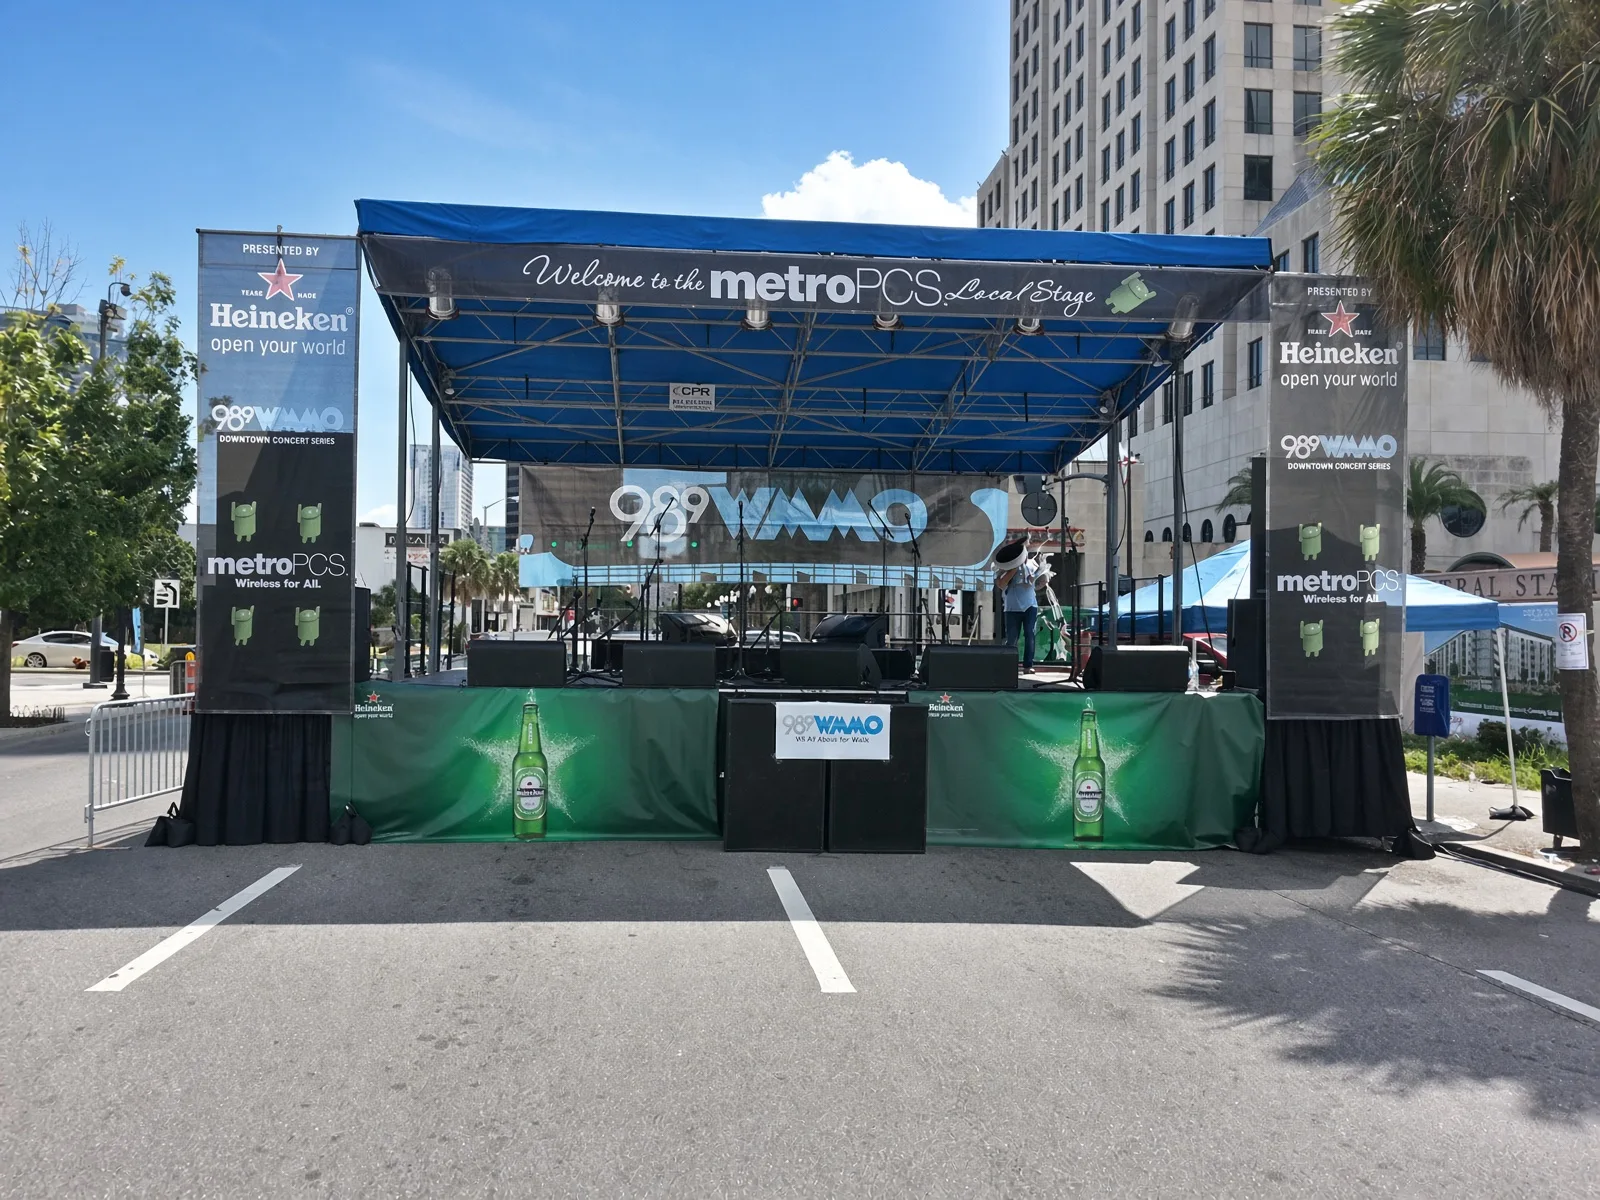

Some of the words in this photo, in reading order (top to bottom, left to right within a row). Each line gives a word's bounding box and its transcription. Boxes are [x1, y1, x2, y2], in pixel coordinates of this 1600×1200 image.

[242, 243, 302, 256] PRESENTED
[305, 246, 319, 257] BY
[522, 254, 645, 288] Welcome
[650, 272, 670, 290] to
[674, 268, 705, 291] the
[944, 277, 1034, 301] Local
[1029, 279, 1096, 317] Stage
[1307, 287, 1358, 297] PRESENTED
[1361, 288, 1373, 297] BY
[211, 337, 254, 355] open
[259, 339, 298, 356] your
[302, 339, 346, 356] world
[1280, 372, 1319, 389] open
[1323, 372, 1357, 389] your
[1360, 371, 1398, 387] world
[681, 386, 710, 396] CPR
[219, 434, 271, 444] DOWNTOWN
[272, 435, 309, 445] CONCERT
[310, 437, 335, 445] SERIES
[1287, 462, 1334, 470] DOWNTOWN
[1335, 462, 1367, 470] CONCERT
[1368, 462, 1391, 470] SERIES
[235, 578, 281, 588] Wireless
[284, 578, 300, 588] for
[1303, 594, 1347, 603] Wireless
[1349, 594, 1364, 603] for
